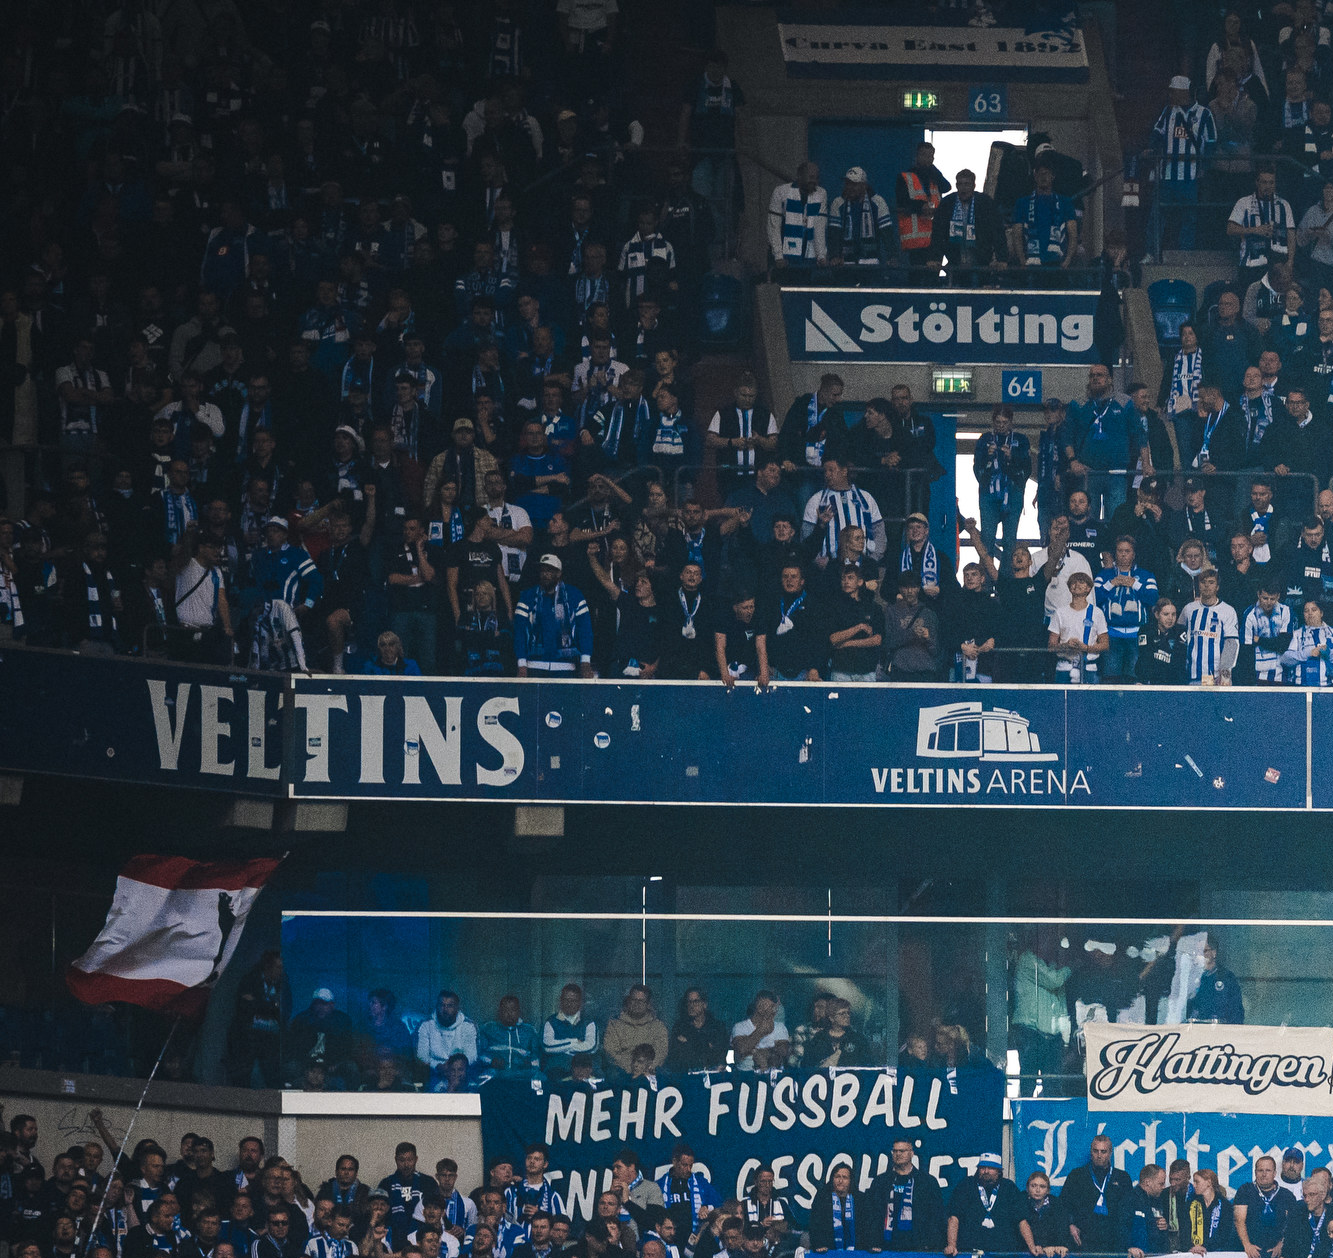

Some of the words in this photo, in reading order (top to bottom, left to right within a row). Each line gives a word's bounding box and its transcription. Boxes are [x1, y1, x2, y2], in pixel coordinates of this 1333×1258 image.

[903, 39, 976, 52] East
[973, 93, 1002, 113] 63
[860, 302, 1093, 352] Stölting
[1008, 376, 1037, 397] 64
[147, 678, 526, 787] VELTINS
[871, 768, 981, 794] VELTINS
[986, 768, 1092, 796] ARENA
[1090, 1032, 1329, 1101] Hattingen
[544, 1086, 683, 1146] MEHR
[707, 1071, 948, 1137] FUSSBALL
